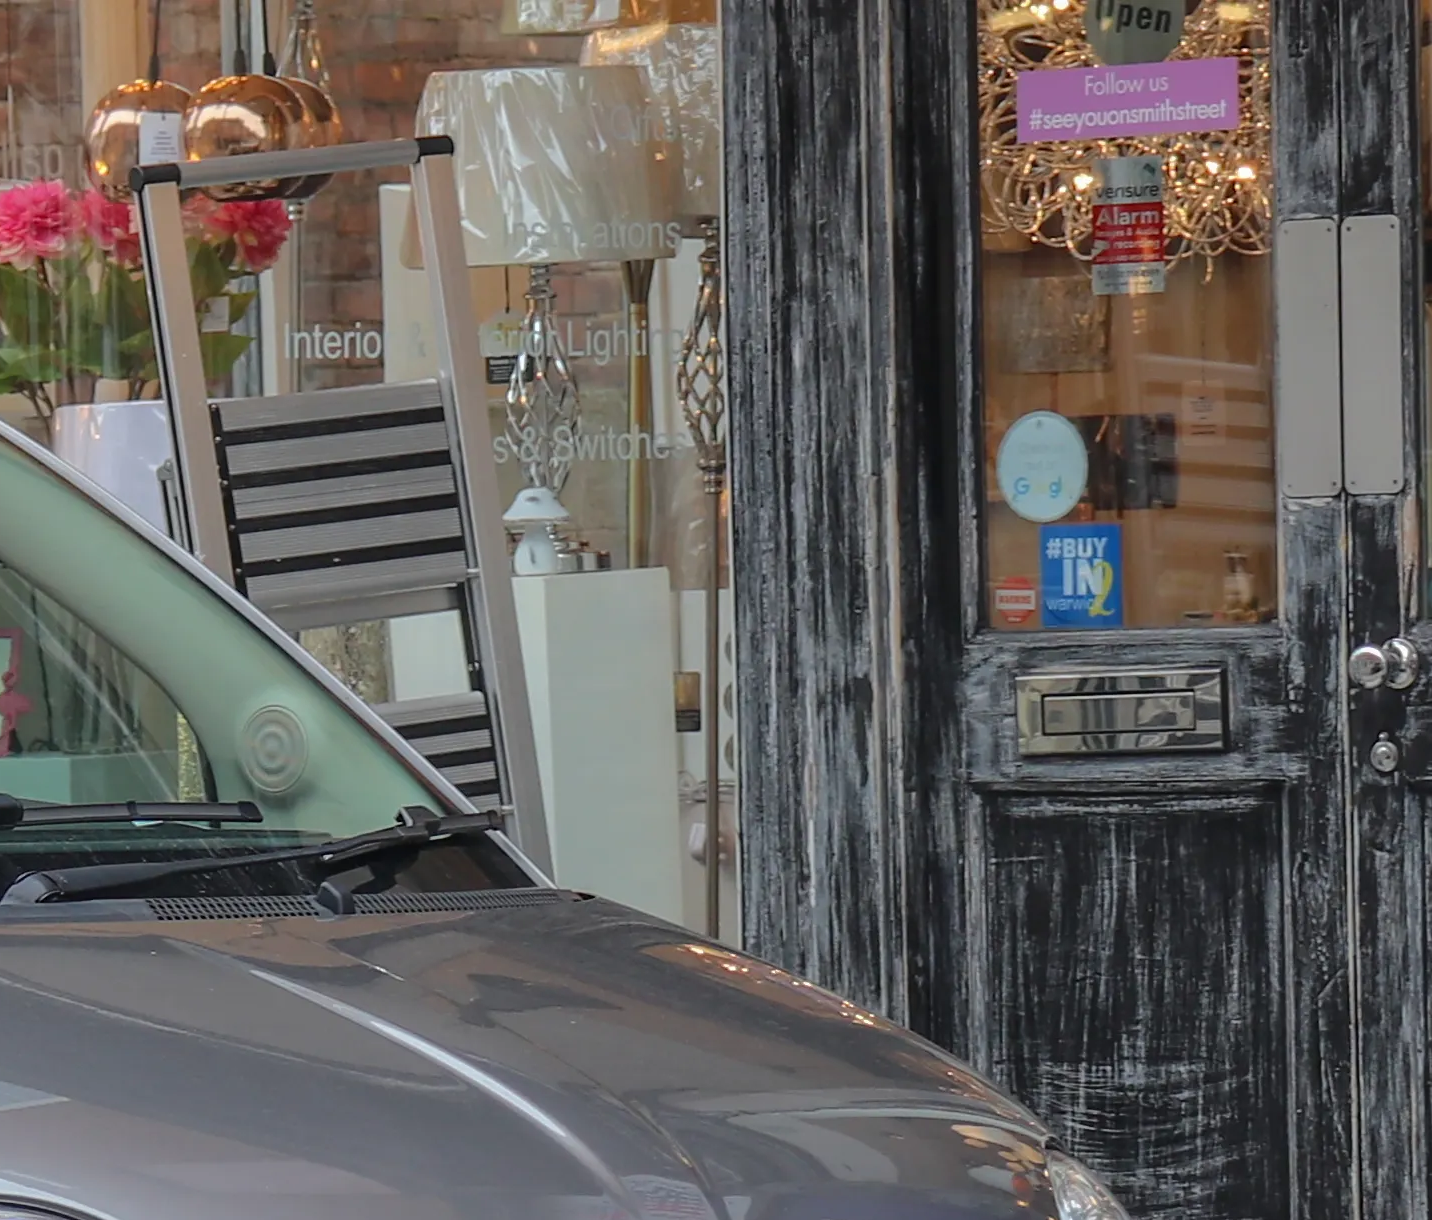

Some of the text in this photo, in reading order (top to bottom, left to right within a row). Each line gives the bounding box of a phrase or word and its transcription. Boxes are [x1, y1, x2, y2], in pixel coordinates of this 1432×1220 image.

[1094, 0, 1172, 33] Open
[1084, 72, 1169, 96] Follow us
[1029, 98, 1226, 133] #seeyouonsmithstreet
[1095, 205, 1160, 226] Alarm
[504, 214, 682, 249] Insaations
[284, 321, 387, 360] Interio
[478, 321, 558, 358] terior
[567, 320, 690, 367] Lighting
[520, 425, 538, 463] &
[553, 424, 687, 462] Switches
[1013, 474, 1071, 499] Ggl
[1046, 537, 1108, 559] #BUY
[1045, 598, 1101, 612] warwi
